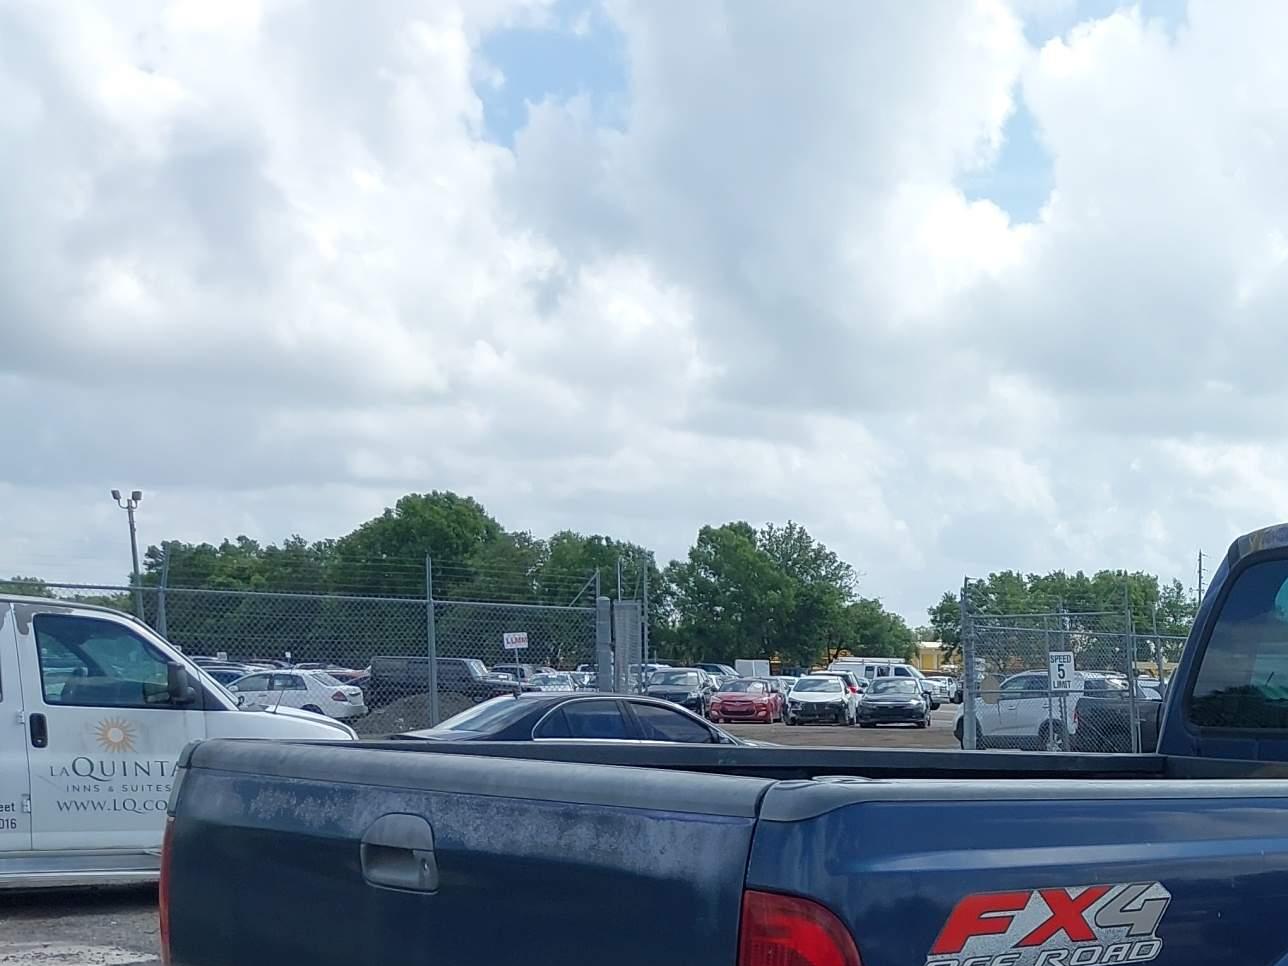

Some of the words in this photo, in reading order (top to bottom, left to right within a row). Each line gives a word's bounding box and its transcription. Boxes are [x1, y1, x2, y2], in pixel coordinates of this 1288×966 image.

[1050, 655, 1071, 663] SPEED
[1058, 664, 1065, 679] 5
[1053, 680, 1071, 688] LIMIT
[66, 784, 101, 793] INNS
[107, 785, 115, 793] &
[121, 784, 171, 793] SUITES
[0, 802, 15, 812] eet
[56, 798, 168, 815] WWW.LQ.CO
[0, 818, 17, 829] 016
[928, 881, 1172, 956] FX4
